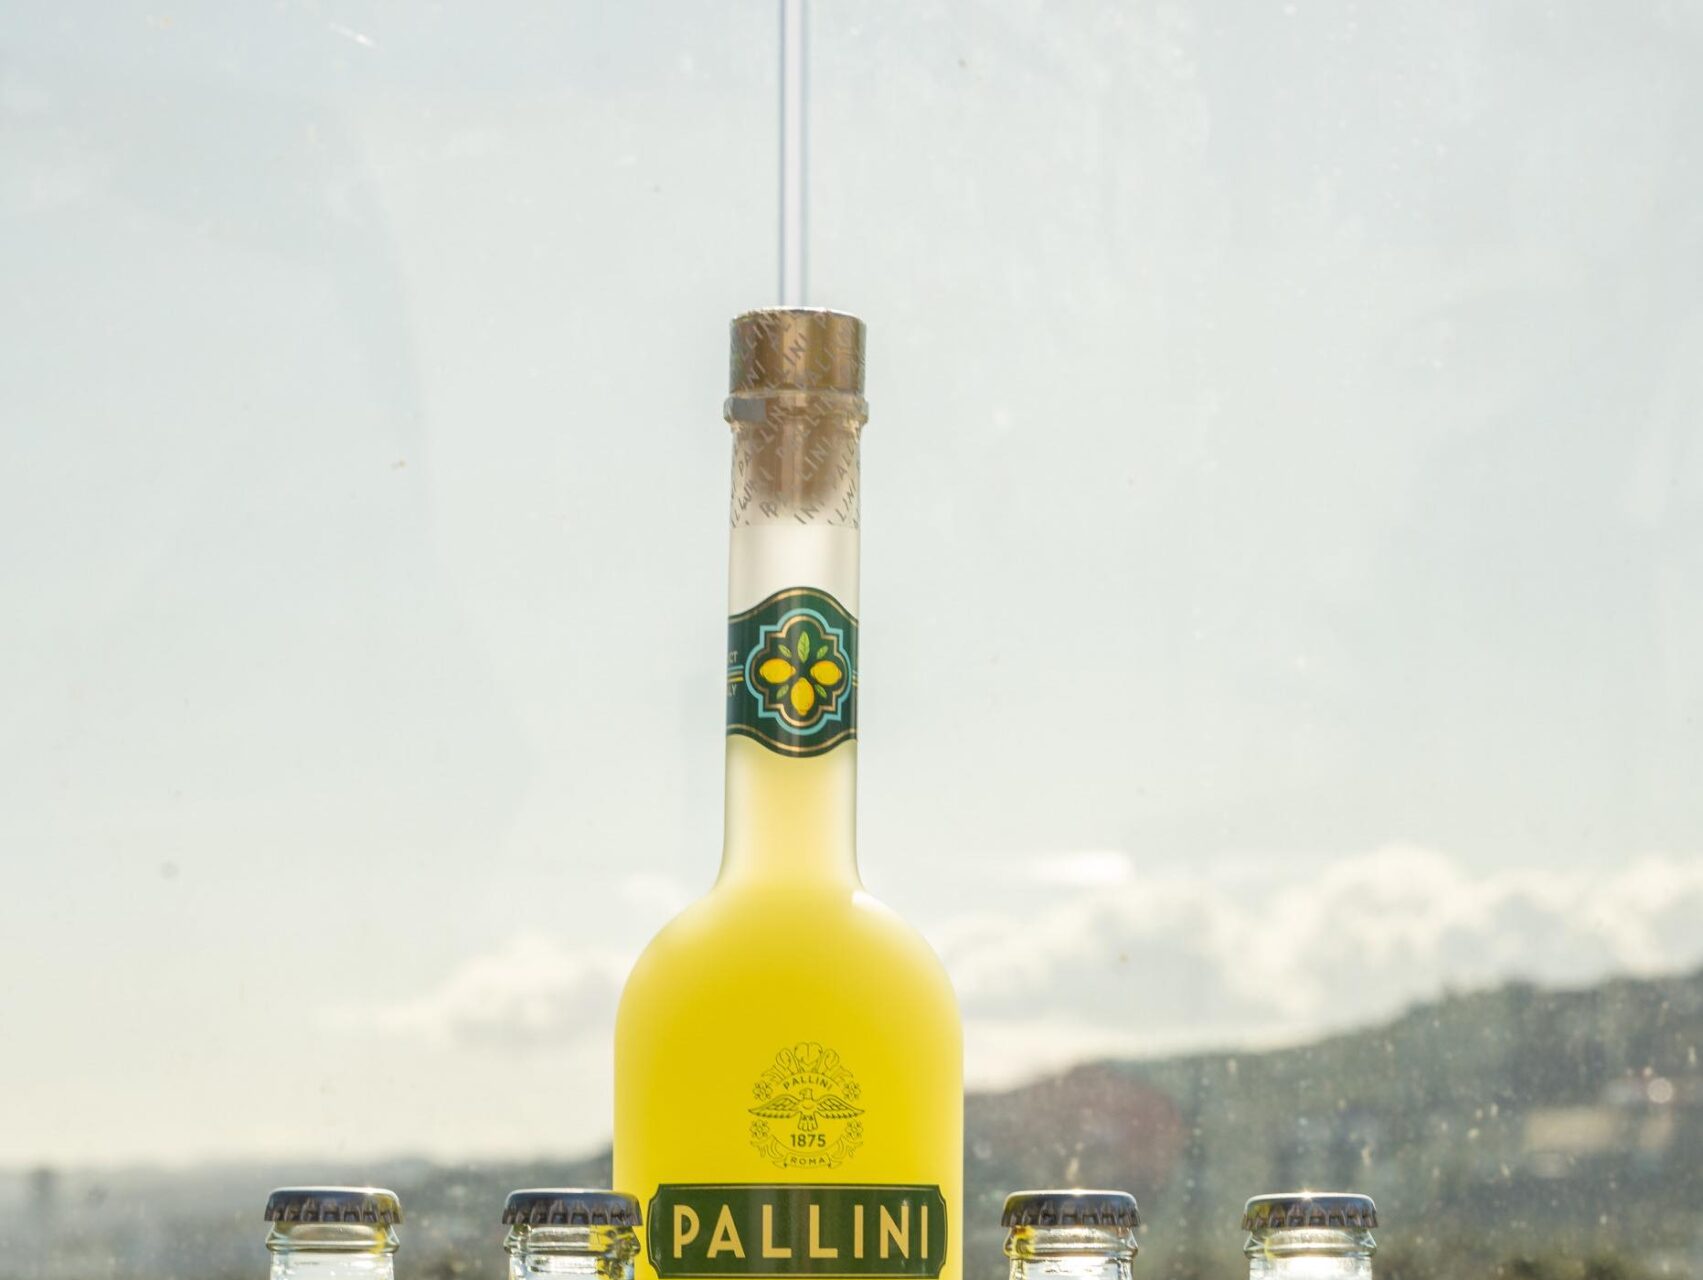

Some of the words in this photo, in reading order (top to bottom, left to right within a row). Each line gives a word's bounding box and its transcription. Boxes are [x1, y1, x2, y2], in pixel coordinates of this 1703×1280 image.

[782, 1075, 833, 1092] PALLINI
[790, 1133, 826, 1148] 1875
[790, 1155, 827, 1166] ROMA
[673, 1204, 929, 1259] PALLINI
